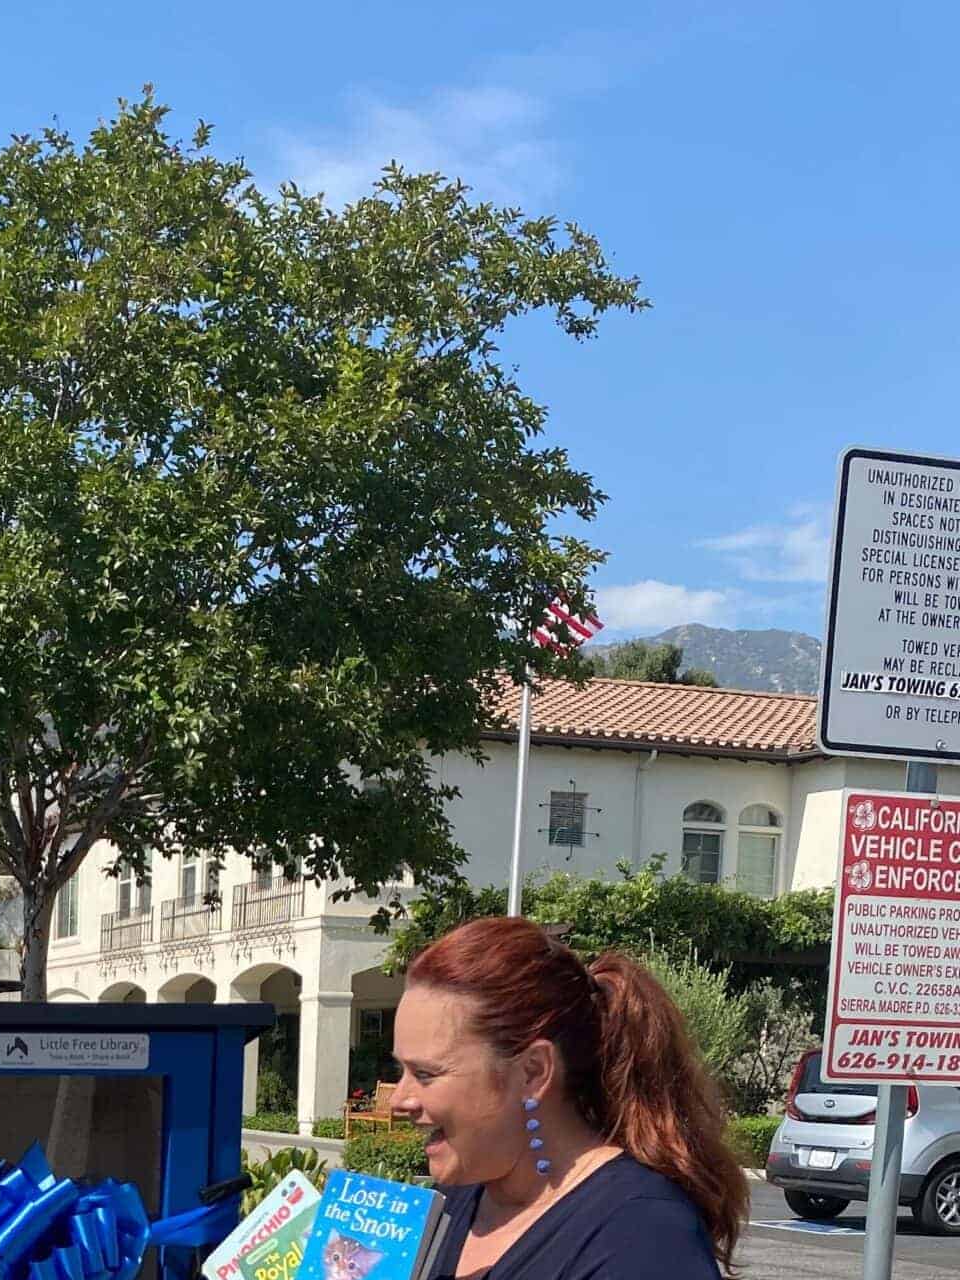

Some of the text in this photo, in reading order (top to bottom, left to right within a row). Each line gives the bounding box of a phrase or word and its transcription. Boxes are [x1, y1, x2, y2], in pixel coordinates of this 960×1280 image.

[868, 468, 954, 493] UNAUTHORIZED
[883, 490, 895, 506] IN
[892, 512, 934, 531] SPACES
[872, 529, 960, 553] DISTINGUISHING
[862, 548, 960, 572] SPECIAL LICENSE
[862, 567, 883, 583] FOR
[889, 570, 942, 590] PERSONS
[894, 589, 919, 606] WILL
[925, 592, 939, 608] BE
[878, 608, 891, 623] AT
[896, 609, 916, 625] THE
[902, 639, 938, 657] TOWED
[883, 657, 905, 674] MAY
[910, 659, 925, 674] BE
[842, 674, 883, 691] JAN'S
[888, 677, 945, 697] TOWING
[886, 705, 901, 720] OR
[906, 707, 920, 722] BY
[851, 834, 943, 864] VEHICLE
[847, 903, 886, 919] PUBLIC
[890, 905, 936, 921] PARKING
[850, 923, 938, 940] UNAUTHORIZED
[854, 942, 882, 957] WILL
[884, 944, 899, 957] BE
[902, 944, 941, 959] TOWED
[847, 962, 892, 976] VEHICLE
[894, 964, 941, 979] OWNER'S
[874, 981, 912, 996] C.V.C.
[840, 998, 876, 1013] SIERRA
[879, 1000, 913, 1014] MADRE
[40, 1037, 139, 1055] Little Free Library
[848, 1029, 900, 1048] JAN'S
[339, 1177, 409, 1214] Lost in
[324, 1201, 412, 1241] the Snow
